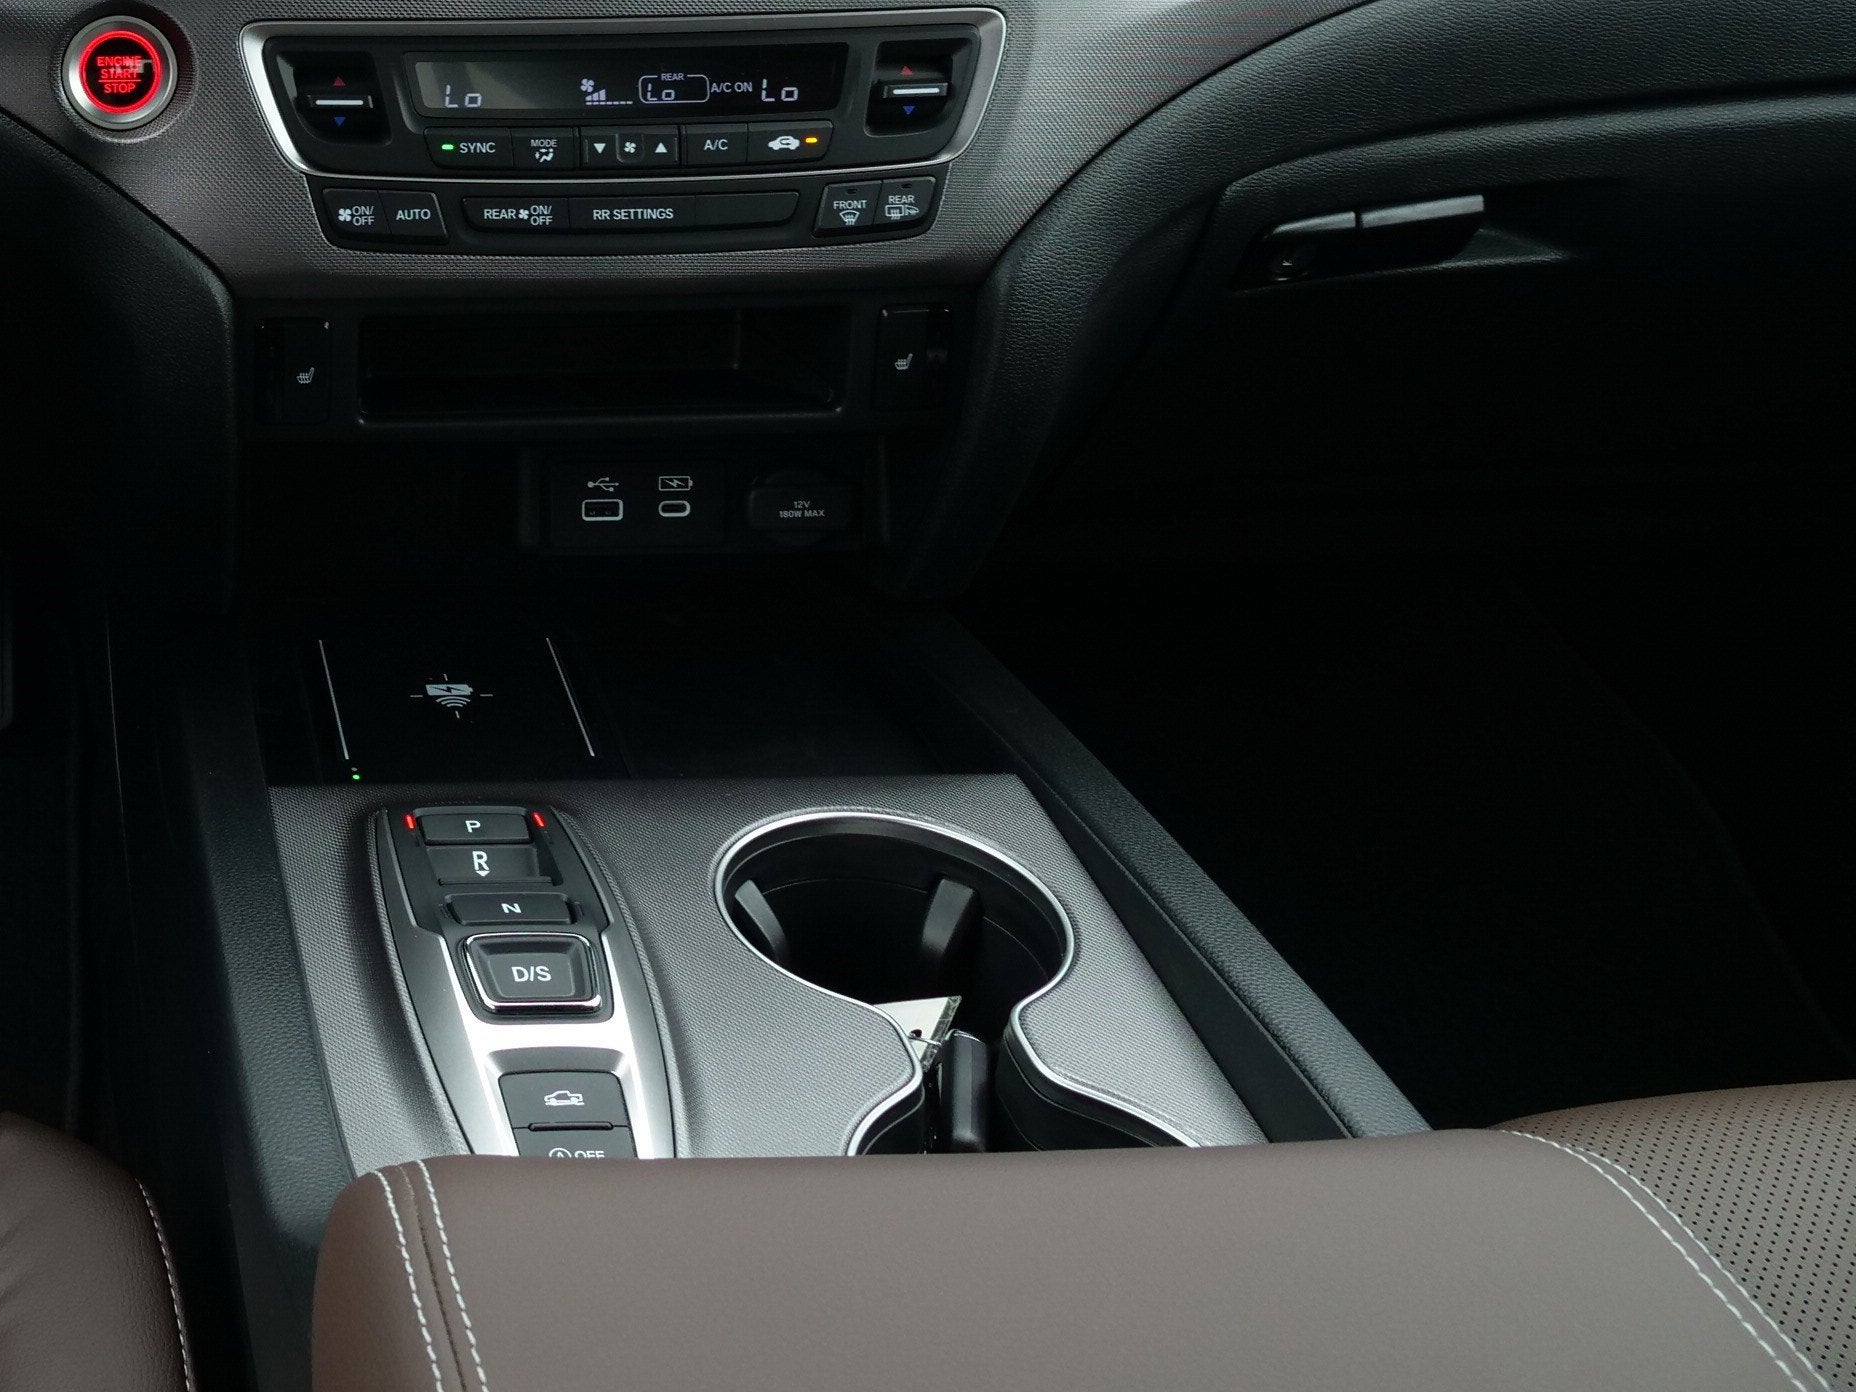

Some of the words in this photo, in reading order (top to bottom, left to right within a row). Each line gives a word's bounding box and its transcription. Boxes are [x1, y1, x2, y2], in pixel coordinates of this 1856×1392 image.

[96, 56, 142, 67] ENGINE
[100, 68, 139, 79] START
[661, 72, 684, 81] REAR
[104, 82, 136, 93] STOP
[647, 83, 675, 101] Lo
[711, 82, 733, 93] A/C
[734, 81, 753, 93] ON
[761, 78, 799, 102] Lo
[444, 84, 483, 108] Lo
[459, 142, 496, 154] SYNC
[530, 139, 557, 148] MODE
[703, 139, 729, 151] A/C
[833, 199, 867, 210] FRONT
[888, 194, 915, 205] REAR
[352, 205, 374, 216] ON/
[396, 209, 431, 221] AUTO
[484, 209, 516, 220] REAR
[530, 205, 552, 216] ON/
[593, 209, 611, 221] RR
[613, 208, 674, 221] SETTINGS
[352, 216, 375, 227] OFF
[530, 216, 553, 227] OFF
[793, 500, 811, 509] 12V
[804, 509, 825, 517] MAX
[465, 820, 481, 833] P
[472, 850, 489, 871] R
[501, 903, 522, 914] N
[511, 965, 552, 983] D/S
